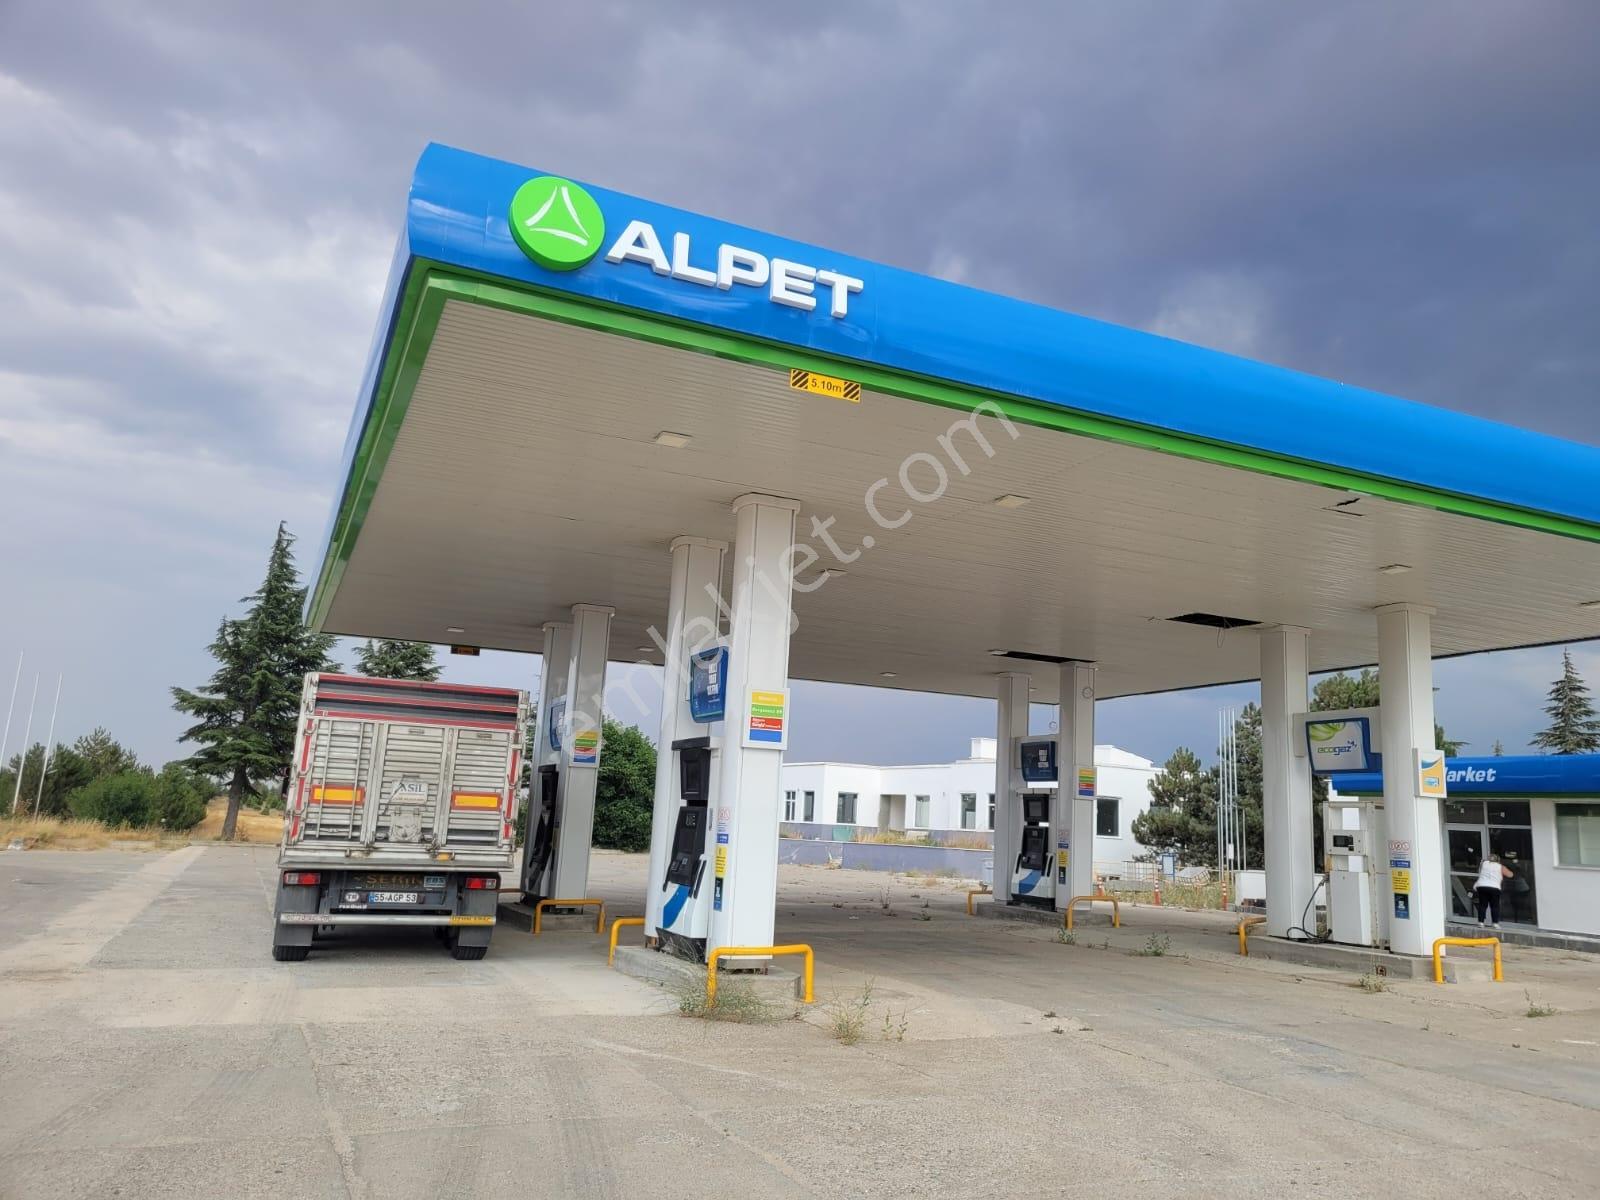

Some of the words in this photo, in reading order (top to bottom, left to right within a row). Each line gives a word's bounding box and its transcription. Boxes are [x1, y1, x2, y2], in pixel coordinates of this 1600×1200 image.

[605, 220, 864, 318] ALPET
[811, 378, 842, 393] 5.10m
[1445, 765, 1497, 782] arket
[375, 893, 385, 902] 55
[387, 893, 404, 902] AGP
[406, 893, 416, 902] 53
